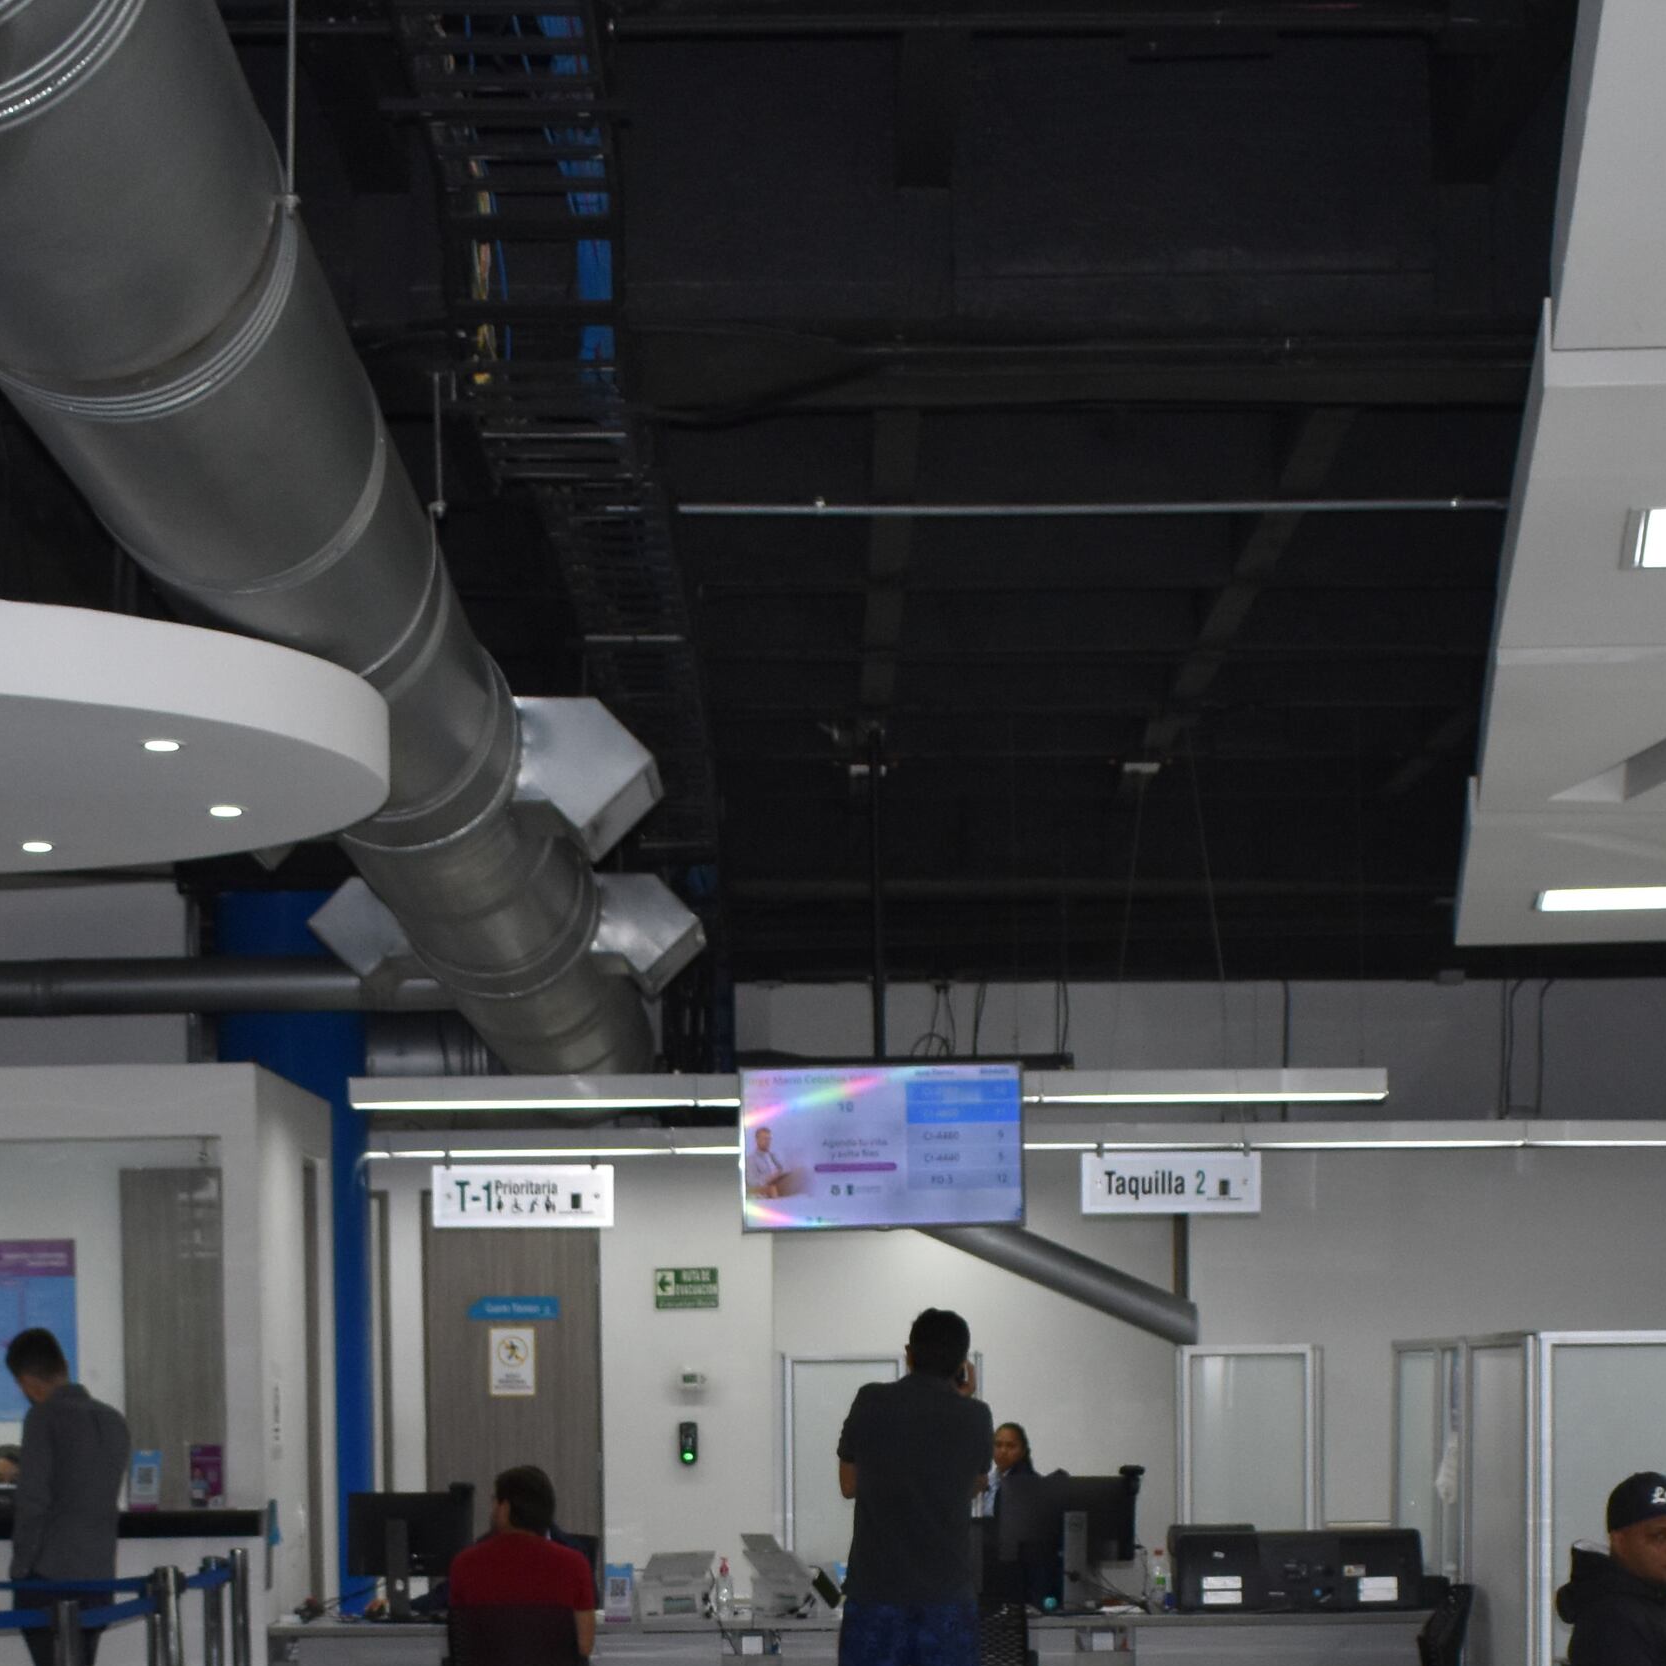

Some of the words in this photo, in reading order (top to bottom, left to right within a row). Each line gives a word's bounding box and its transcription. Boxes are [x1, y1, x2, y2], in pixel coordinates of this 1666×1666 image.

[454, 1180, 492, 1212] T-1
[494, 1179, 558, 1196] Prioritaria
[1104, 1170, 1186, 1201] Taquilla
[1194, 1169, 1207, 1196] 2
